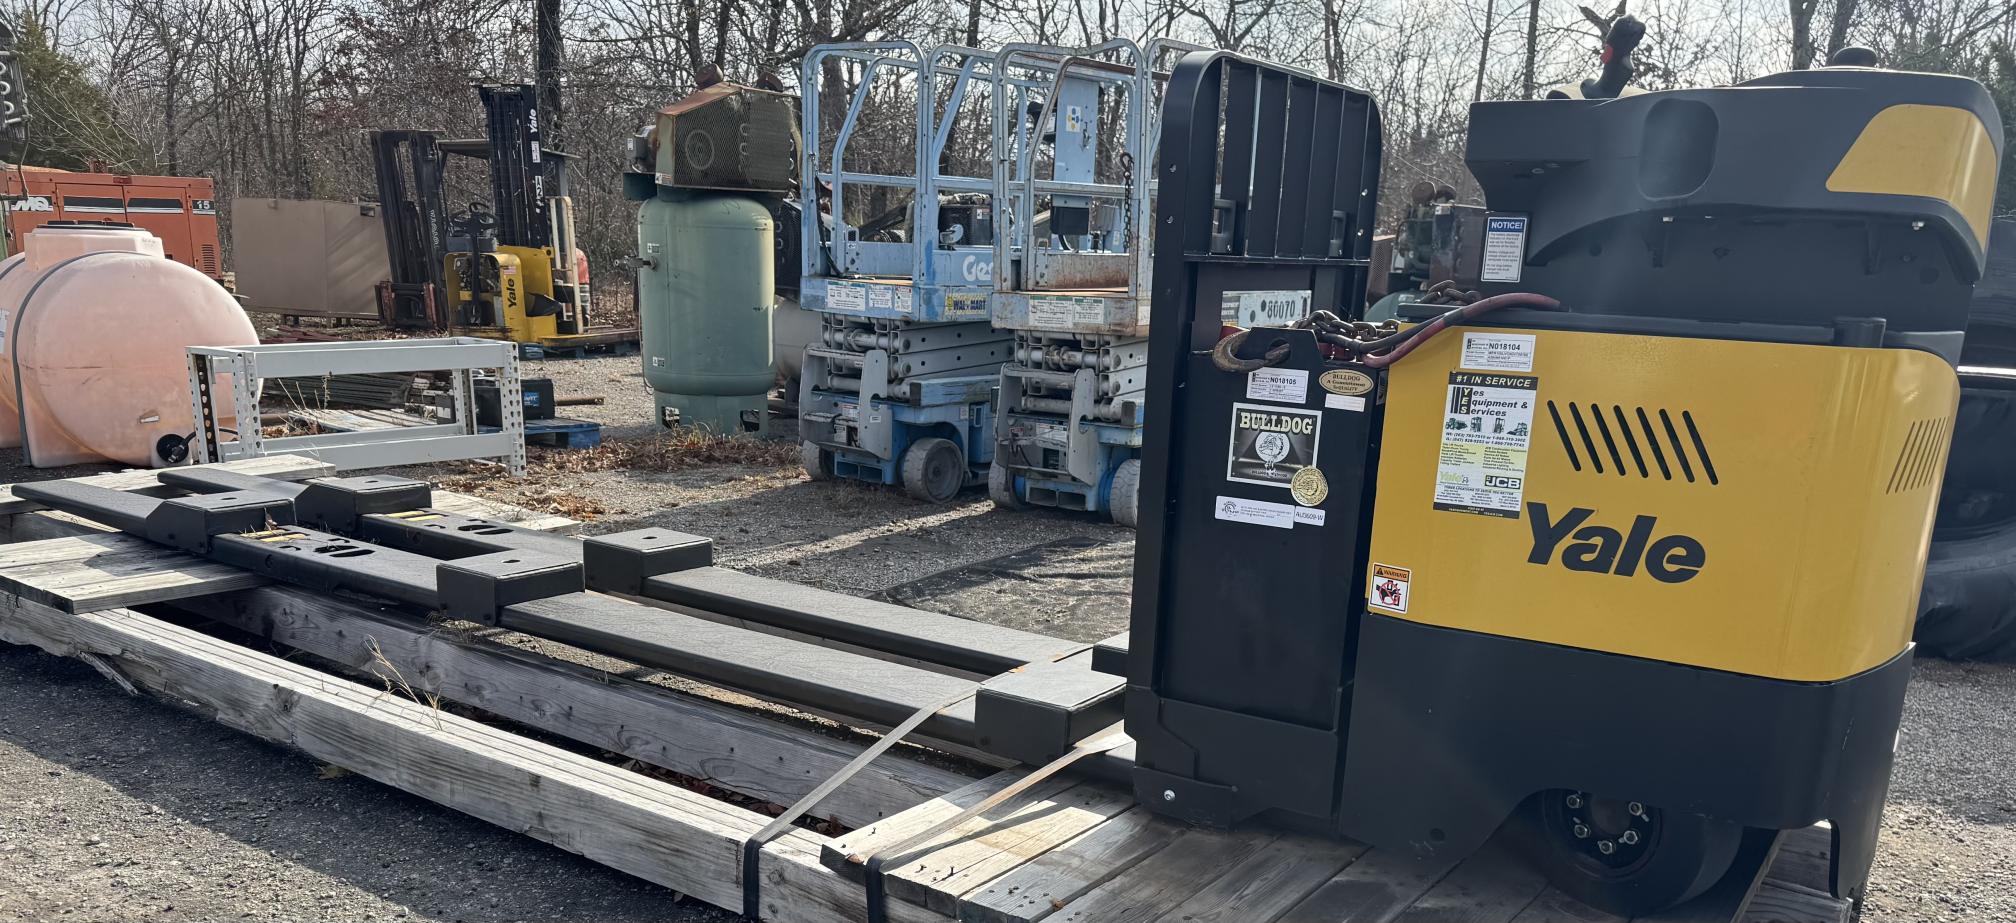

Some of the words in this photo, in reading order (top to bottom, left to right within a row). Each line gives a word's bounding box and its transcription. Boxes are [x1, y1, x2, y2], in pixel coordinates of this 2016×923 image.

[527, 108, 538, 133] Yale
[196, 200, 210, 209] 15
[1491, 221, 1523, 229] NOTICE!
[506, 278, 517, 308] Yale
[1488, 342, 1521, 351] N018104
[1270, 376, 1297, 385] N018105
[1456, 375, 1468, 383] #1
[1471, 376, 1482, 384] IN
[1485, 377, 1532, 387] SERVICE
[1521, 401, 1528, 409] &
[1239, 411, 1313, 435] BULLDOG
[1486, 476, 1520, 489] JCB
[1527, 501, 1706, 583] Yale
[1383, 569, 1407, 579] WARNING
